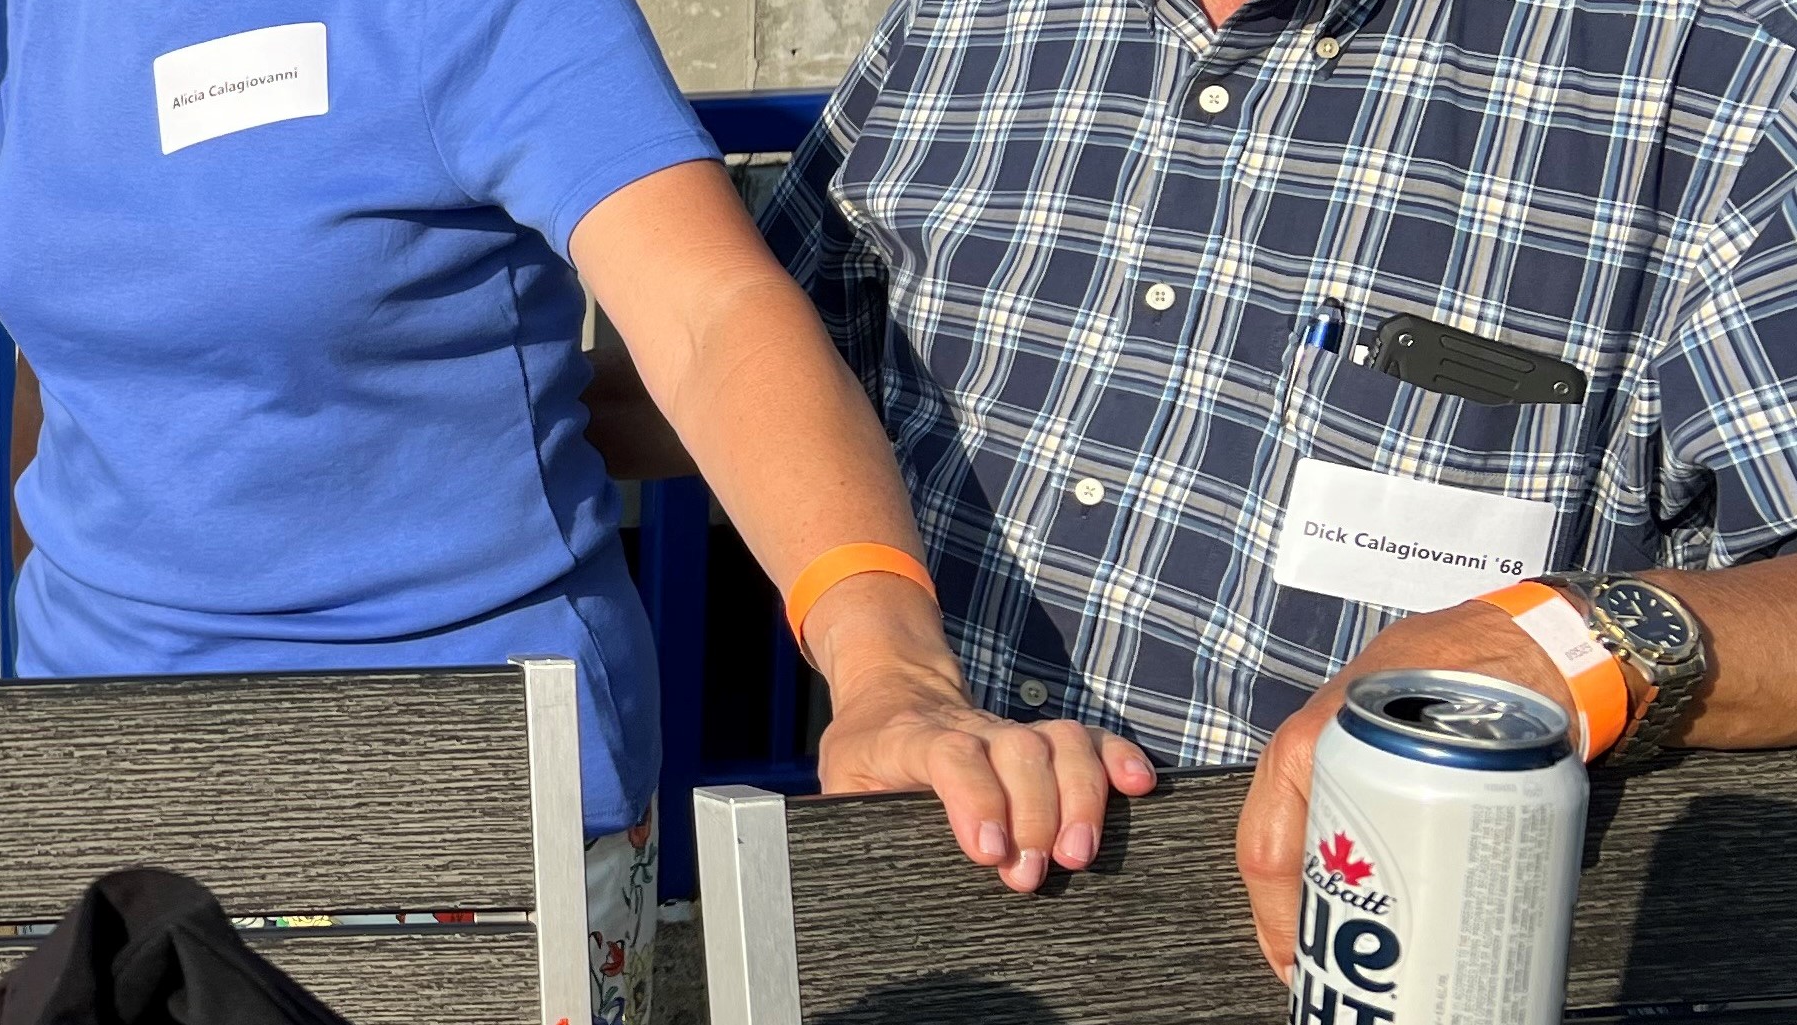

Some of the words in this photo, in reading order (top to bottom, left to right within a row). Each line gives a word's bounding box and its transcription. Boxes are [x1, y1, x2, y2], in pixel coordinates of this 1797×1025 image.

[172, 91, 205, 109] Alicia
[208, 67, 299, 94] Calagiovanni
[1303, 520, 1349, 544] Dick
[1354, 532, 1488, 570] Calagiovanni
[1300, 878, 1401, 993] ue
